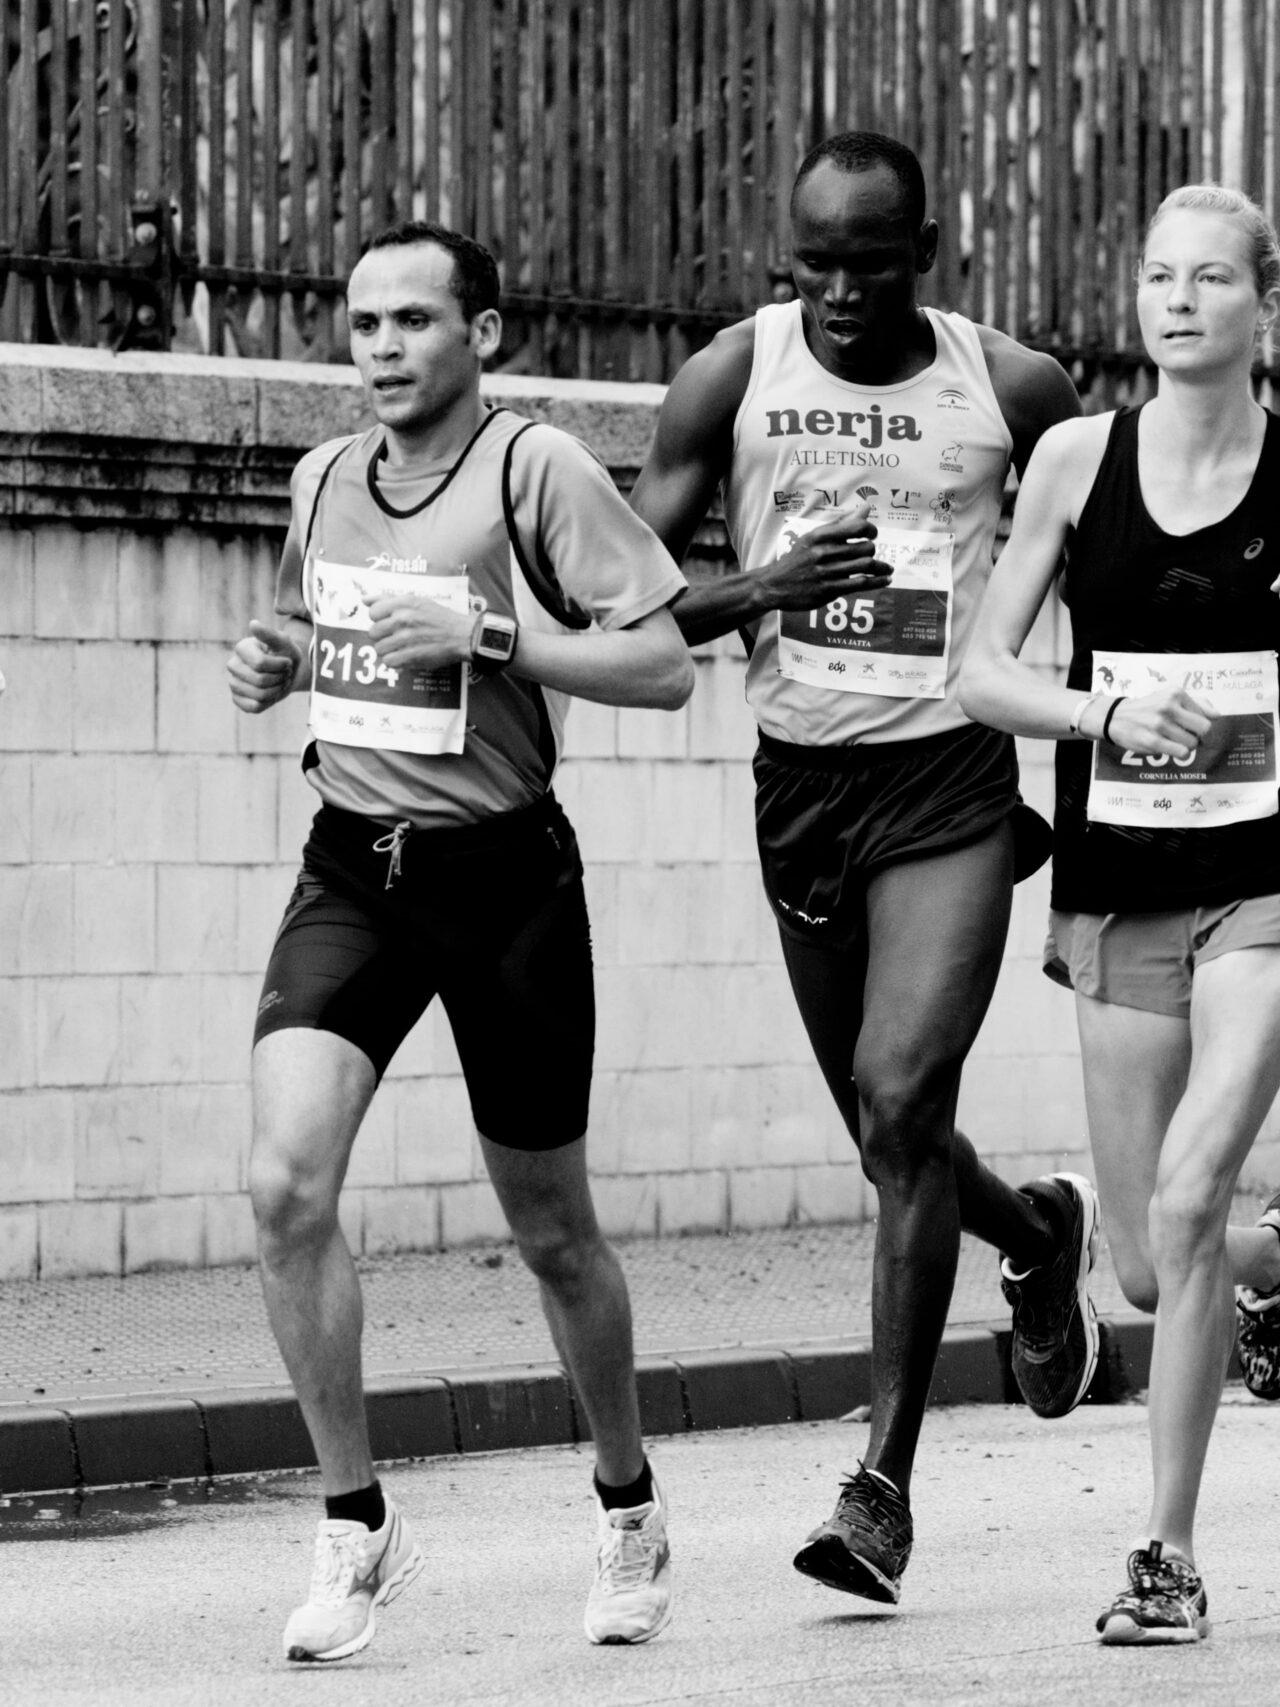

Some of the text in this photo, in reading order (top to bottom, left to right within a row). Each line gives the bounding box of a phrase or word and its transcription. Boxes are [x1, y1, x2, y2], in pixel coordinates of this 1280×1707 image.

[765, 404, 922, 449] nerja
[790, 450, 900, 468] ATLETISMO
[826, 636, 847, 645] YAYA
[320, 639, 399, 687] 2134
[1139, 772, 1207, 780] CORNELIA MOSER
